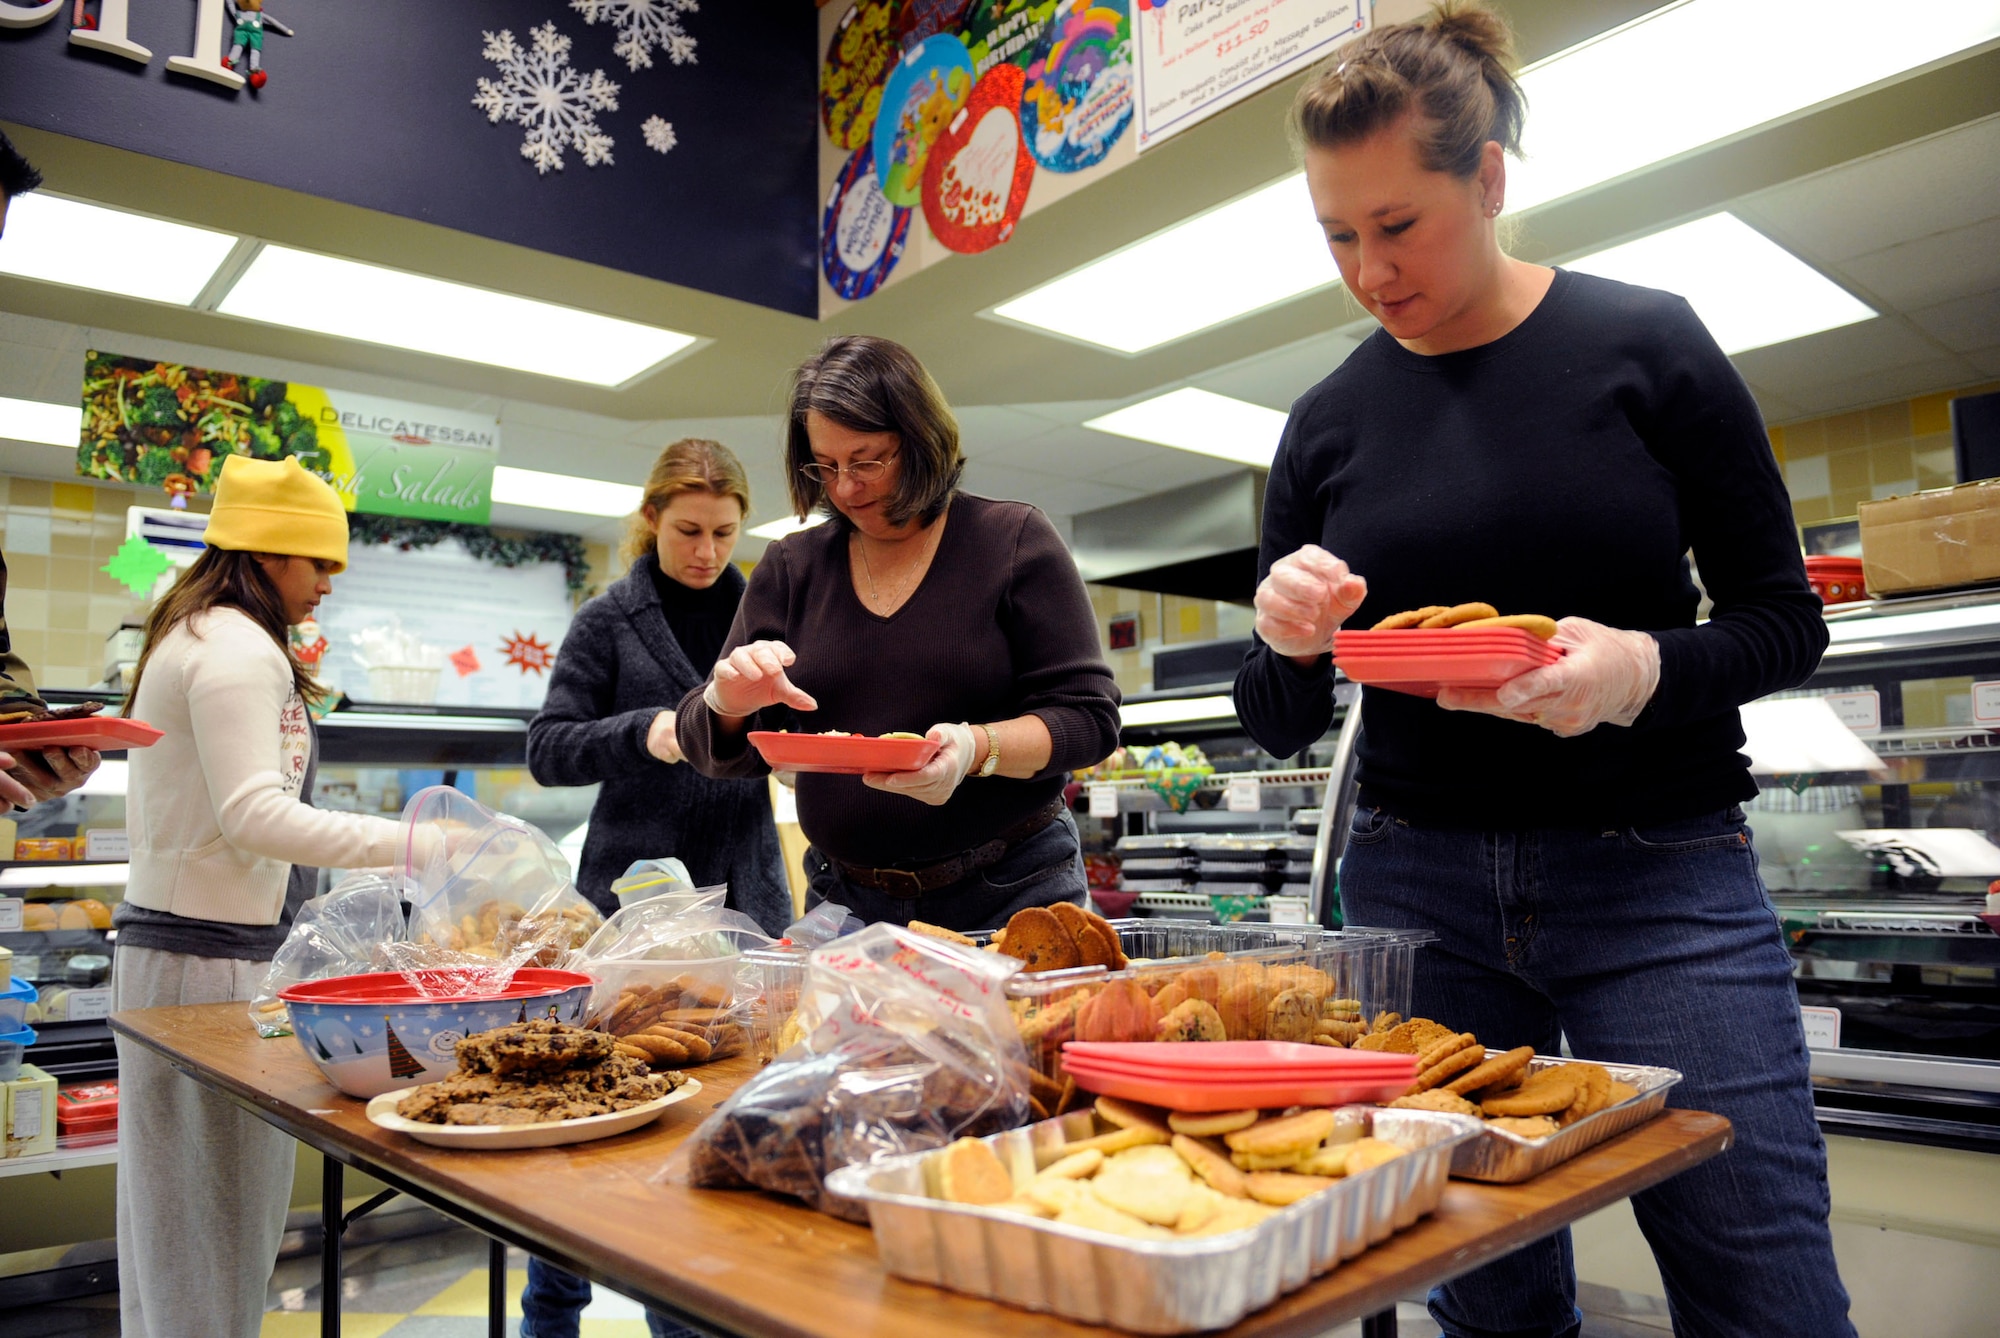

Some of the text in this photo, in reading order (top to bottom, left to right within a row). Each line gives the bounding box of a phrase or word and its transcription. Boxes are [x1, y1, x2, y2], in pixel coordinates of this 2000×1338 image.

[1149, 97, 1178, 117] Balloon
[1180, 75, 1216, 99] Bouquets
[1219, 56, 1249, 78] Consist
[1252, 47, 1262, 60] of
[1274, 24, 1310, 47] Message
[1313, 5, 1349, 28] Balloon
[1190, 90, 1206, 105] and
[1219, 72, 1240, 89] Solid
[1242, 60, 1264, 78] Color
[1268, 43, 1299, 63] Mylars
[321, 406, 494, 447] DELICATESSAN
[378, 455, 484, 511] Salads
